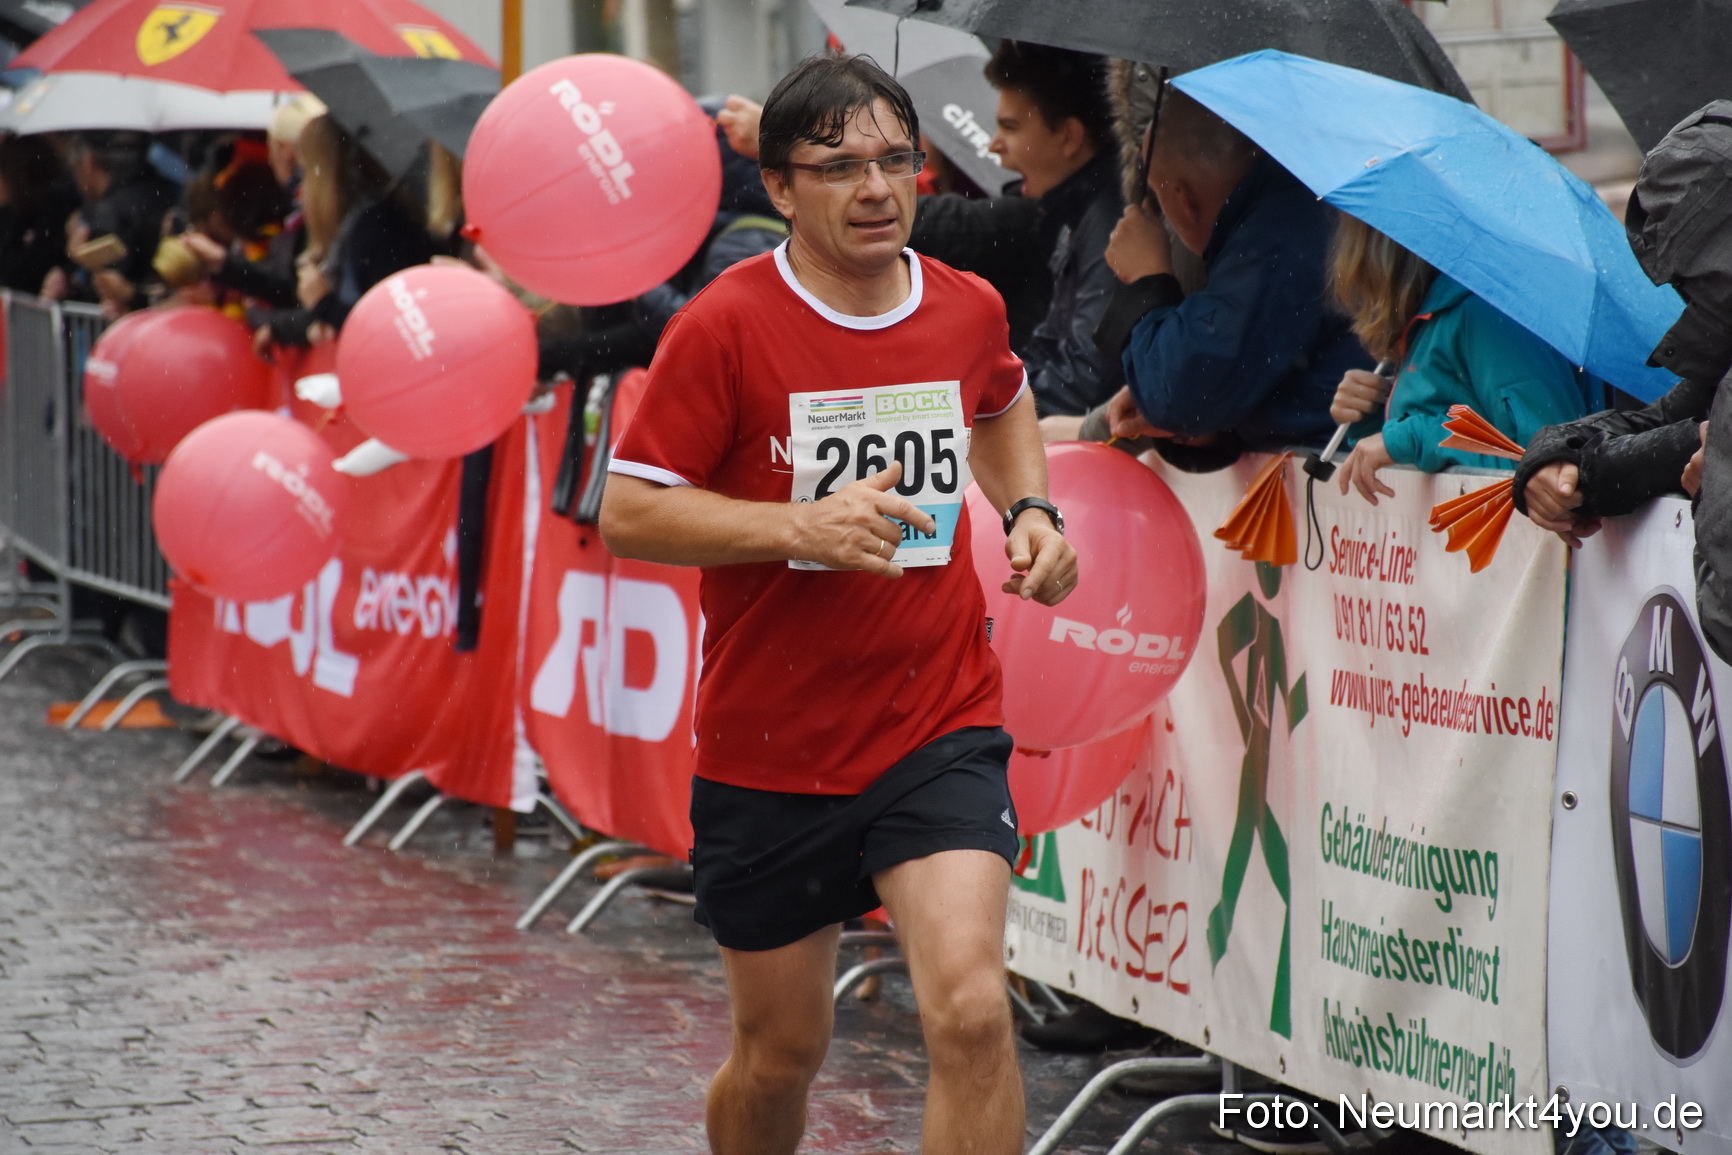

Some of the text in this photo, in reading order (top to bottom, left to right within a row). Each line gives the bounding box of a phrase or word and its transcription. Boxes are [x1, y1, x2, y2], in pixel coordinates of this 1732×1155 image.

[808, 411, 866, 424] NeuerMarkt
[875, 390, 952, 415] BOCK
[931, 411, 954, 419] concepts
[815, 428, 958, 502] 2605
[1329, 525, 1417, 585] Service-Line:
[1330, 663, 1554, 741] www.jura-gebaeudeservice.de
[1321, 801, 1499, 921] Gebäudereinigung
[1321, 899, 1500, 1006] Hausmeisterdienst
[1323, 997, 1515, 1111] Arbeitsbühnenverleih
